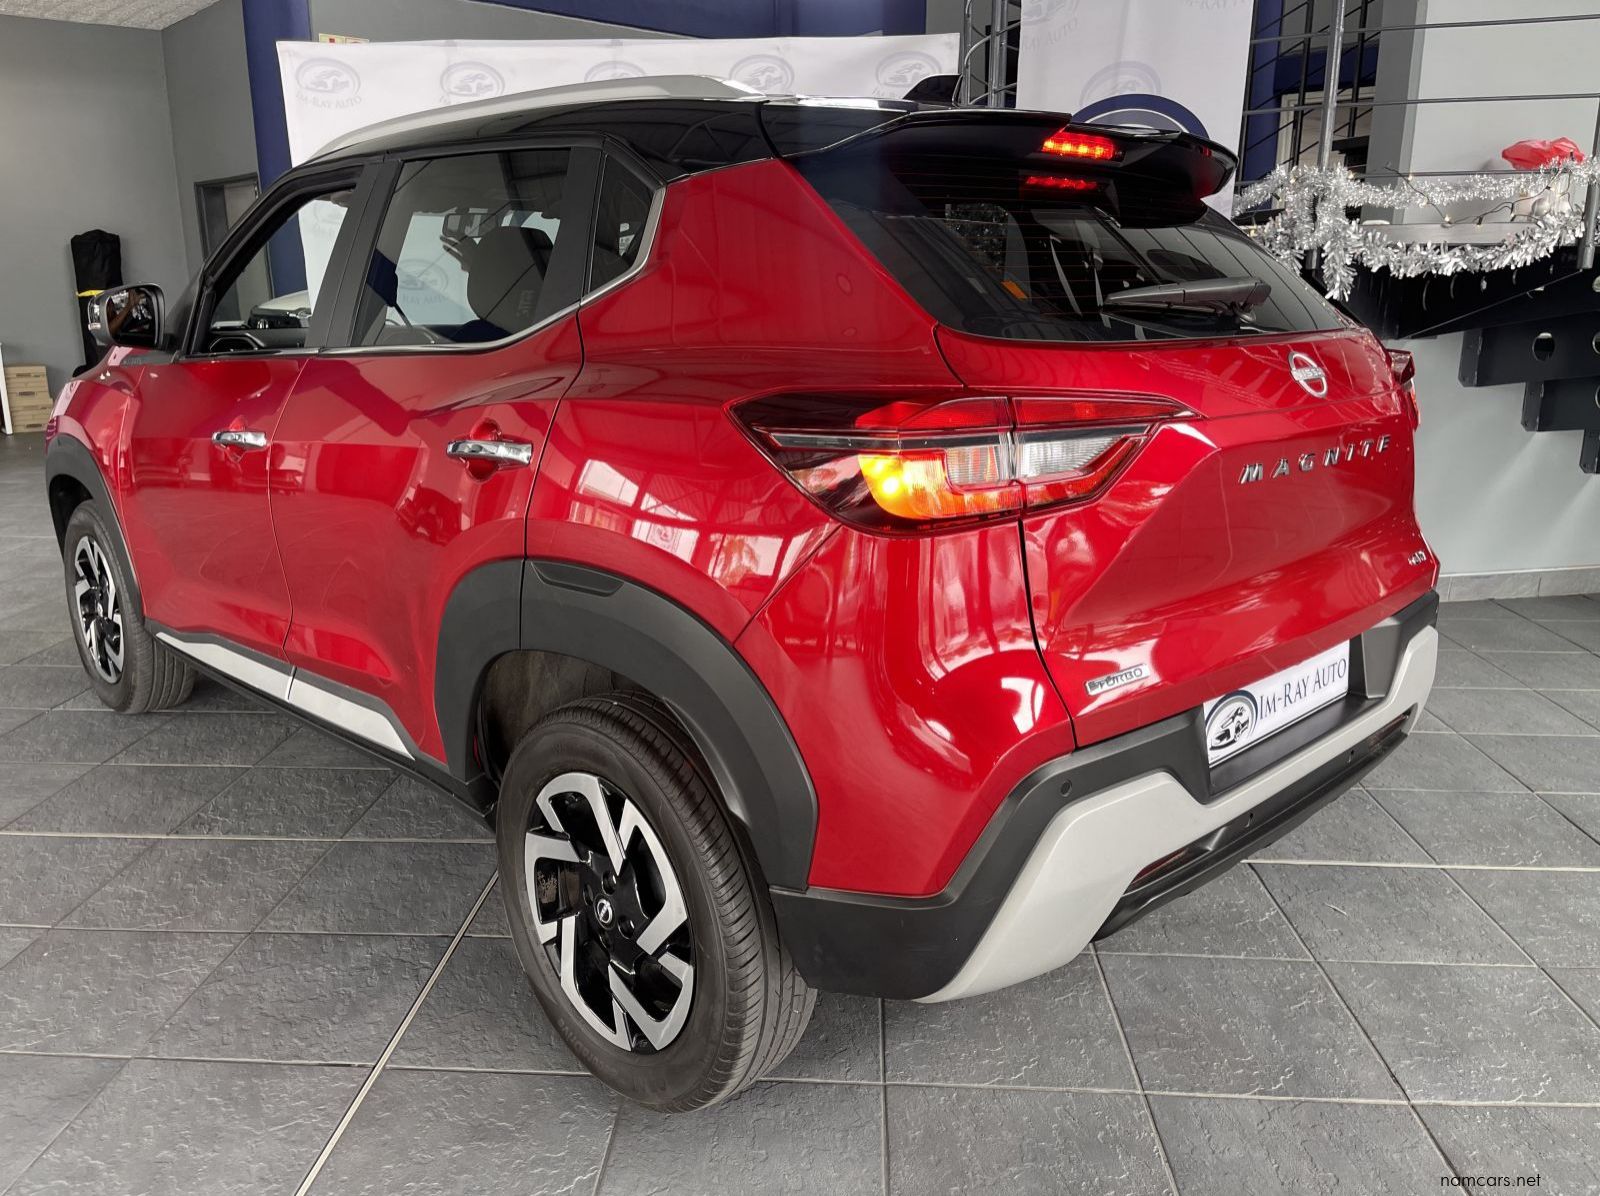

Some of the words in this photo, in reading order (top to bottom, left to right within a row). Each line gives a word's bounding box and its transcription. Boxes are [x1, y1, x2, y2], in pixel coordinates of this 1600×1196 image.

[1238, 434, 1391, 484] MAGNITE
[1259, 675, 1309, 720] IM-RAY
[1312, 658, 1347, 693] AUTO
